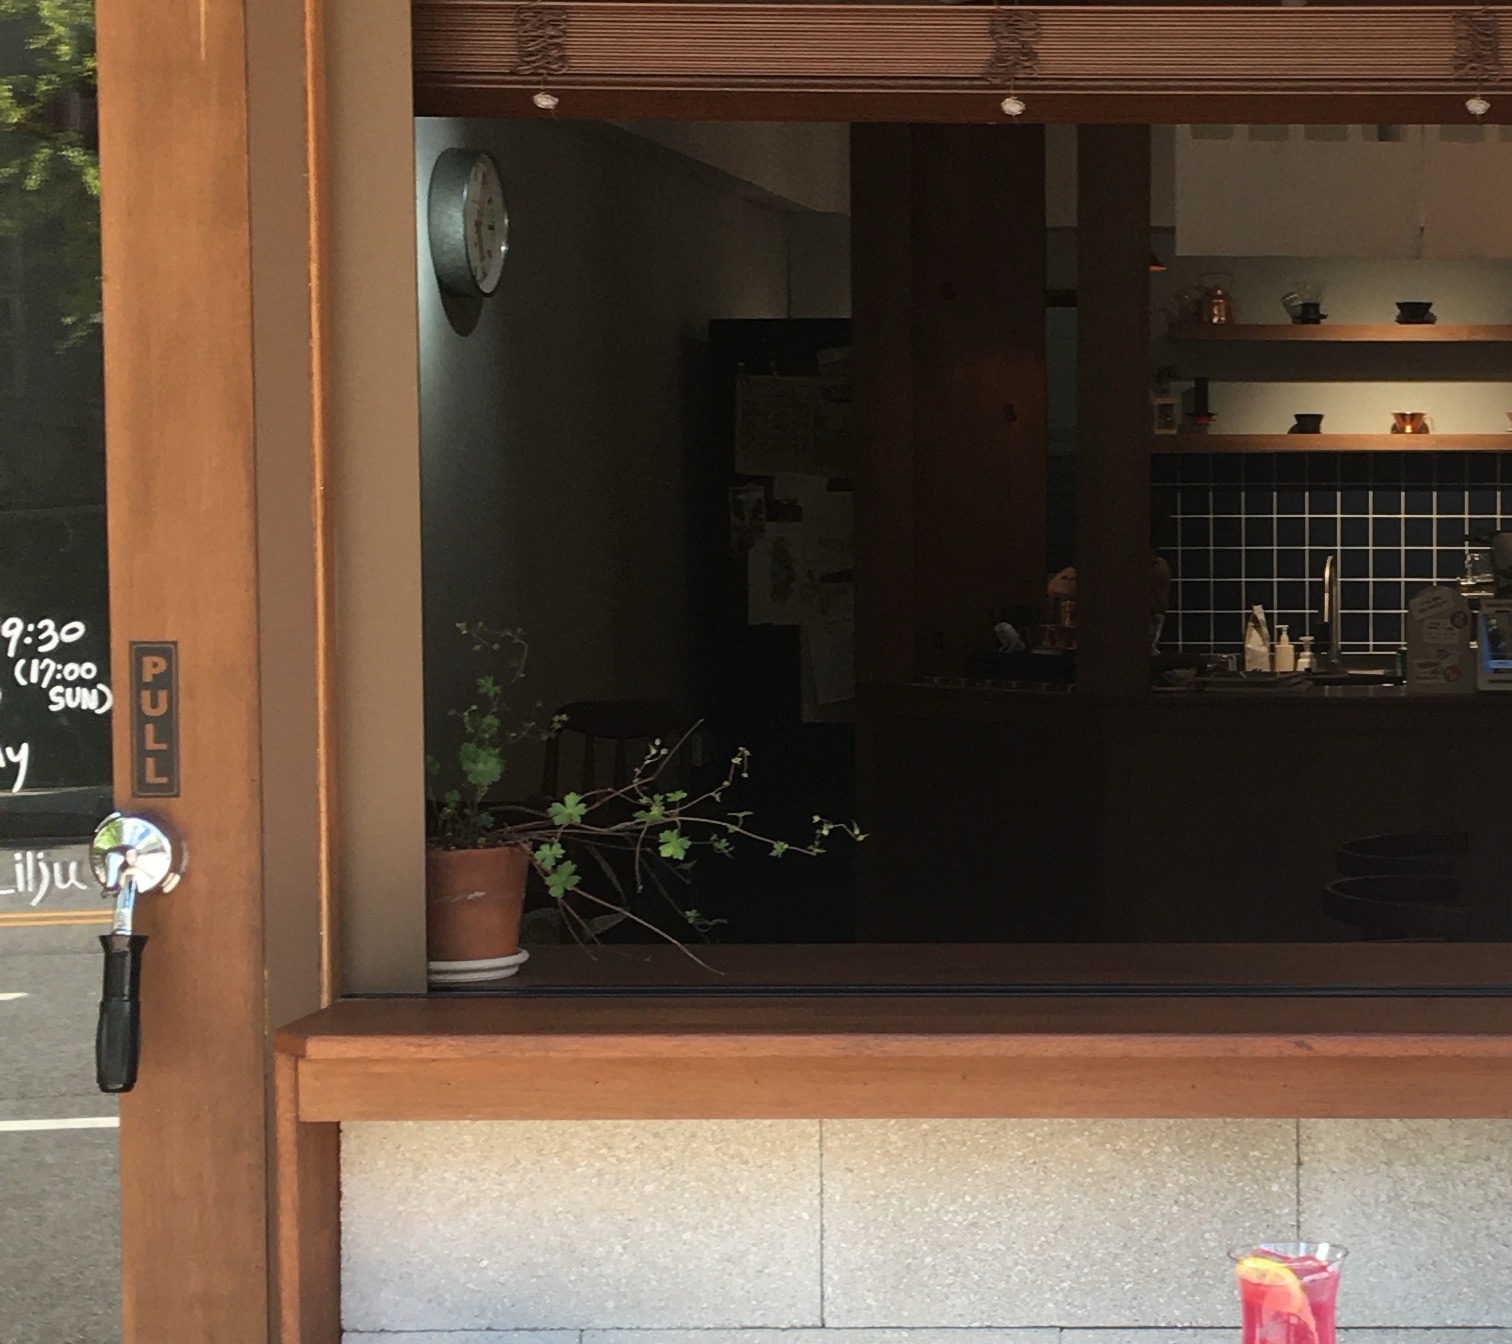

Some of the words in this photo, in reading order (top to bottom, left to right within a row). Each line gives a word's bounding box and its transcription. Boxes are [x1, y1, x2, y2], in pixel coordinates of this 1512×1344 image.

[14, 658, 97, 688] (17:00
[48, 683, 113, 714] SUN)
[140, 655, 170, 785] PULL
